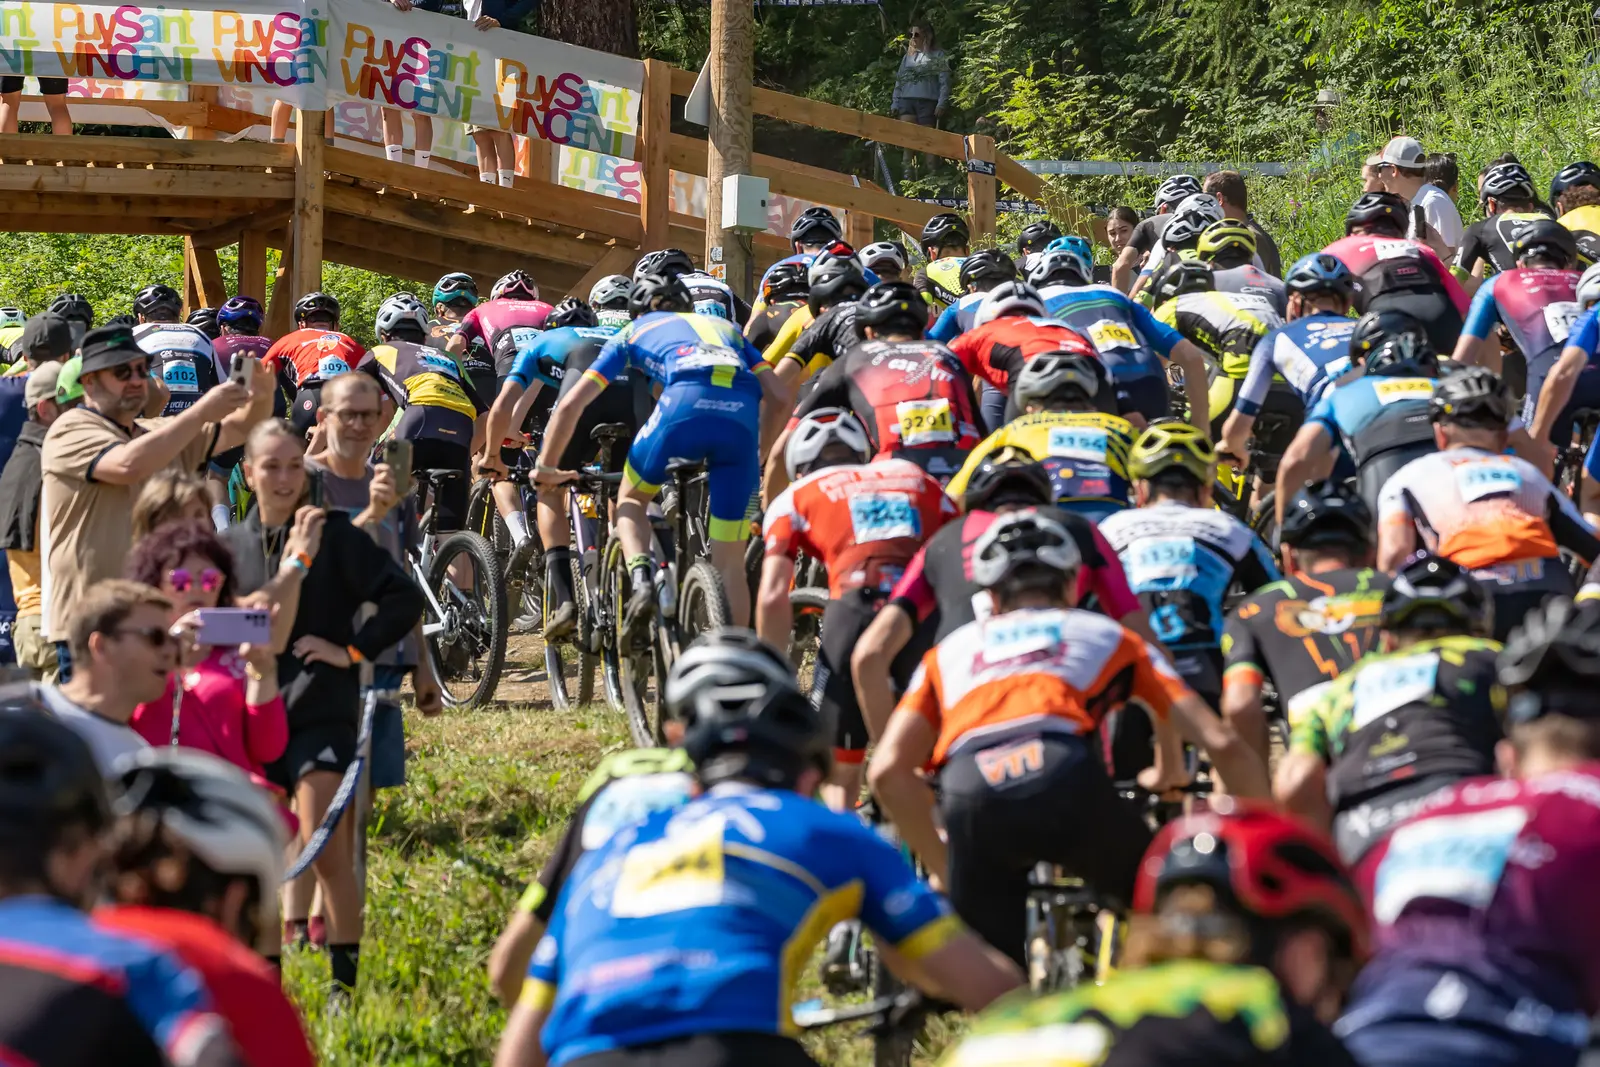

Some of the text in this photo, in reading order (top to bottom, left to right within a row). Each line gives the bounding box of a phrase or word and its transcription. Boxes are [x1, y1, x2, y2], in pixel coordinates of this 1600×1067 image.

[52, 40, 199, 82] VINCENT
[212, 48, 328, 86] VINCEN
[341, 58, 481, 122] VINCENT
[493, 93, 632, 156] VINCENT
[164, 371, 197, 382] 3102
[903, 413, 949, 430] 3201
